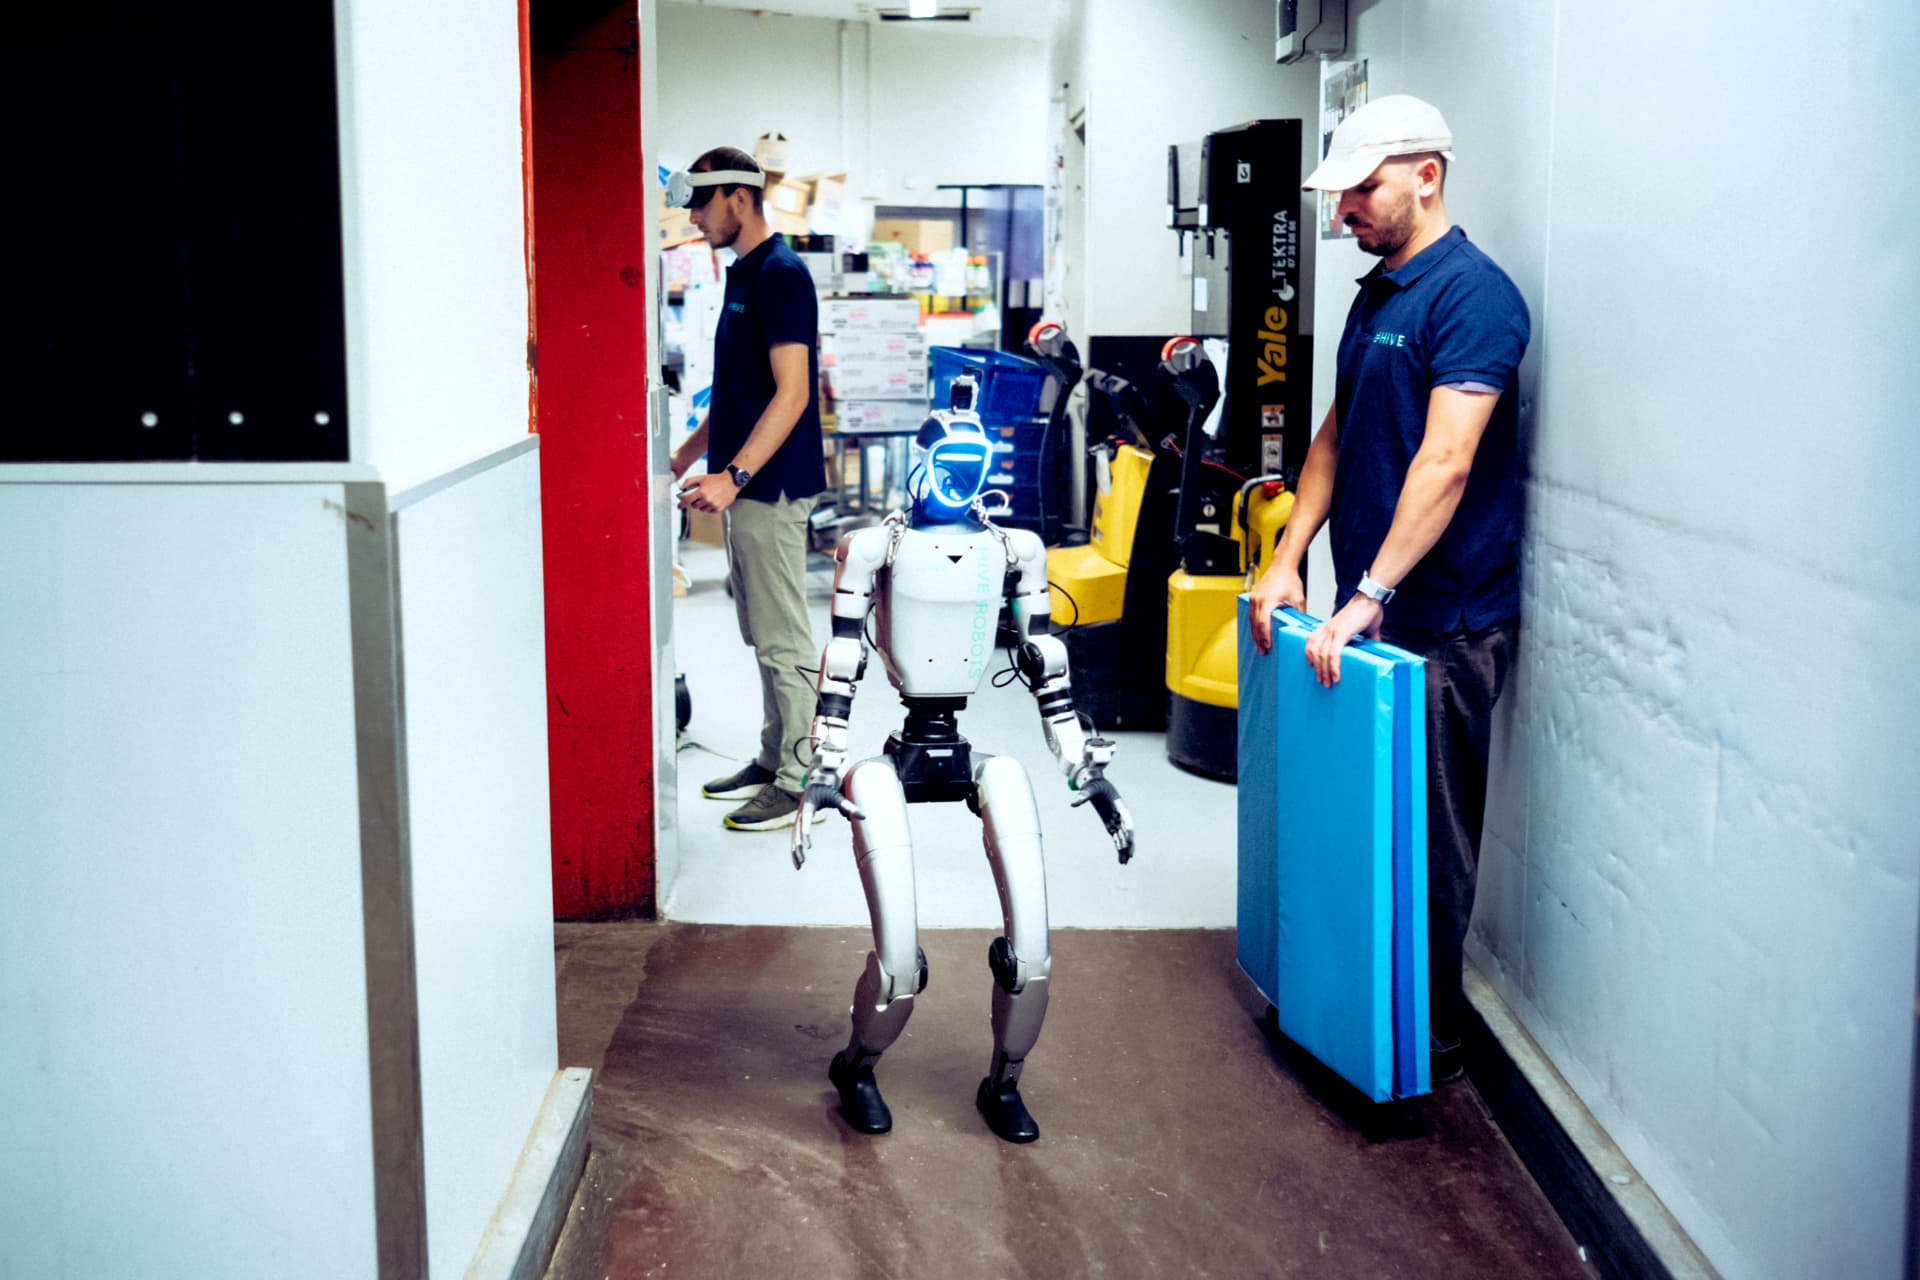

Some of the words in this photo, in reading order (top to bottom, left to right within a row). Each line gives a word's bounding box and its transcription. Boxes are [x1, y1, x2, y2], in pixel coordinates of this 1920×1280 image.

[1272, 209, 1288, 280] TEKTRA
[1257, 306, 1287, 386] Yale
[976, 547, 991, 593] HIVE
[968, 603, 988, 680] ROBOTS
